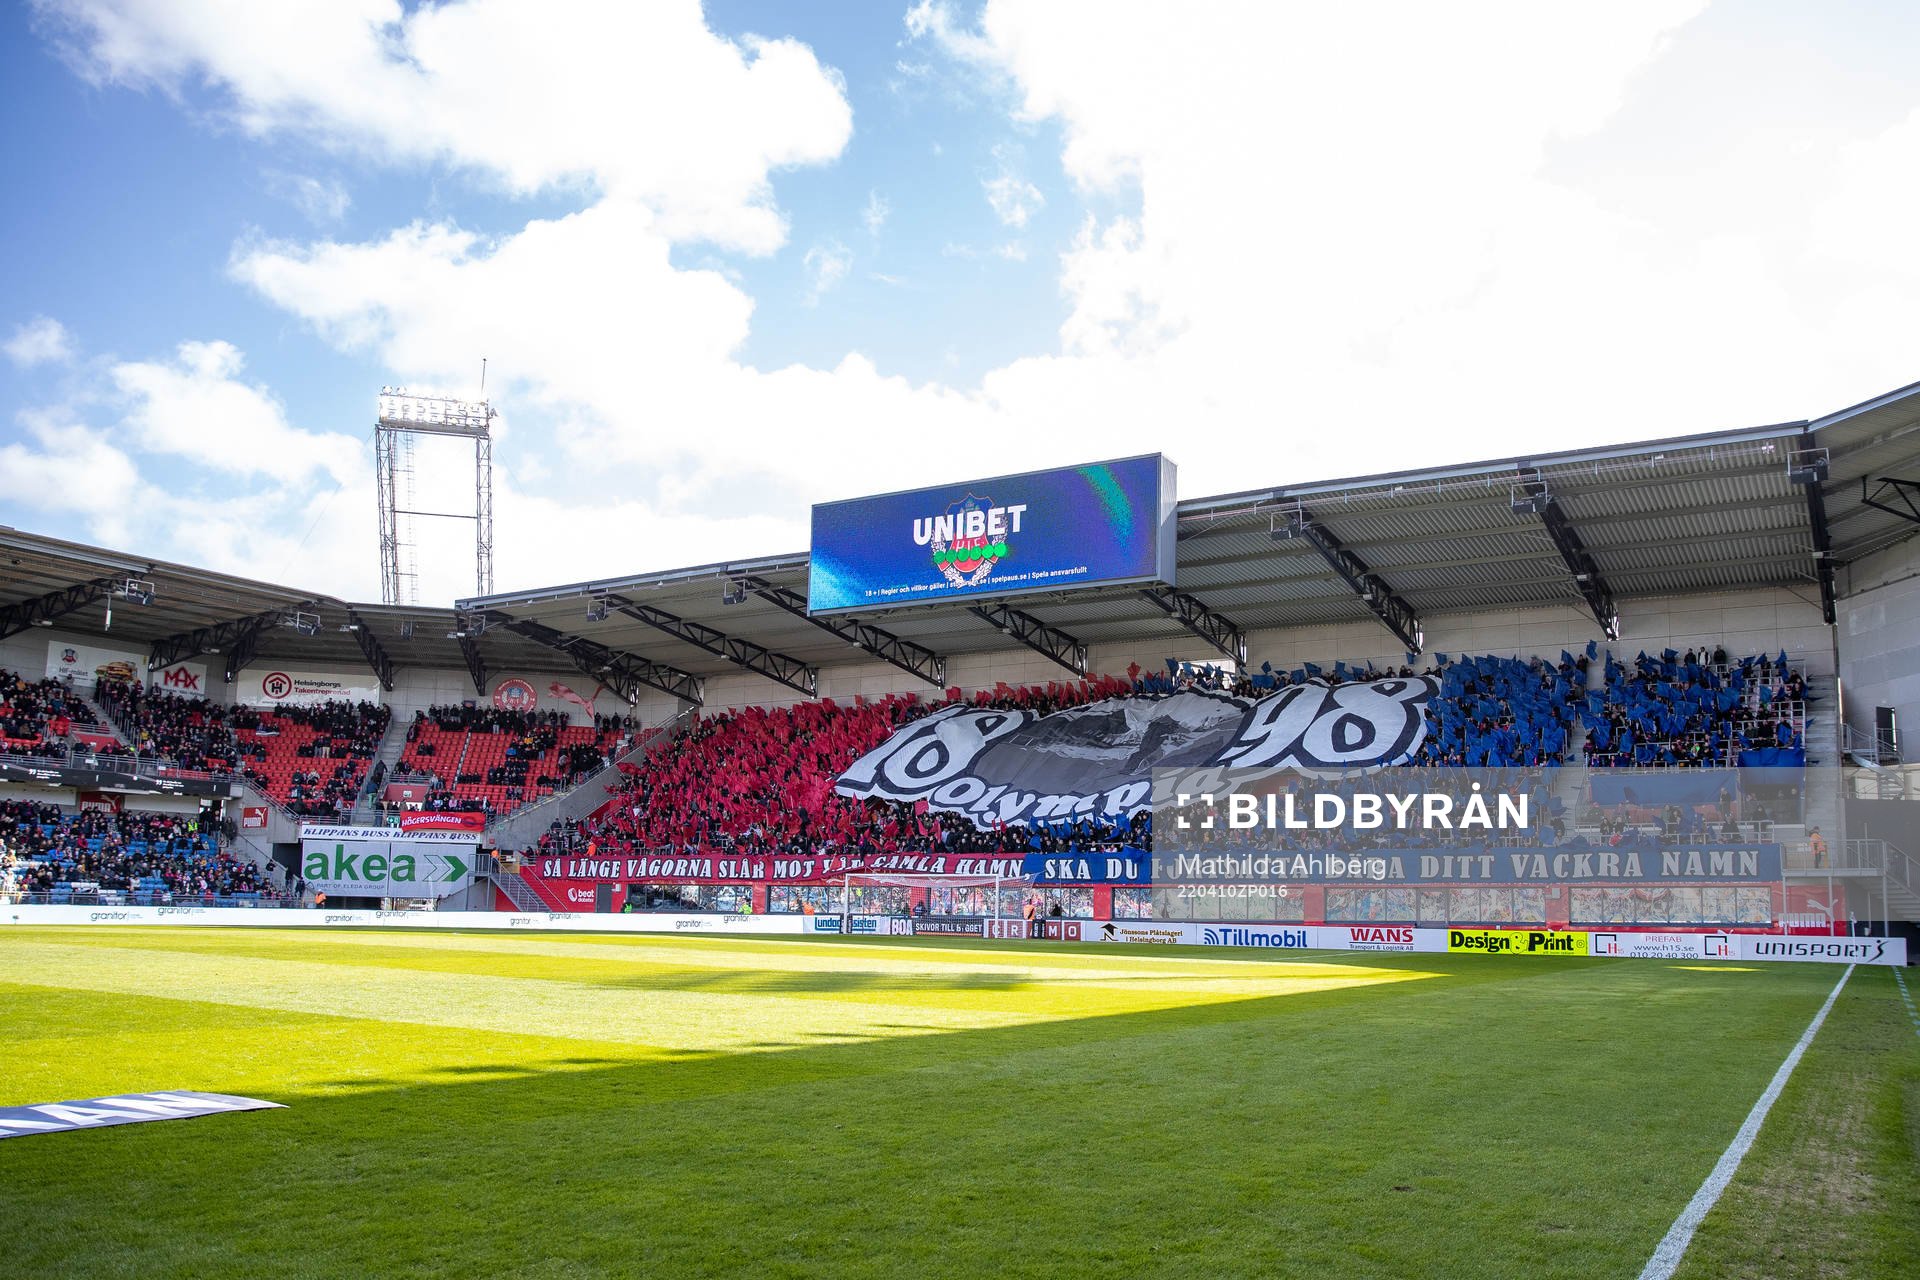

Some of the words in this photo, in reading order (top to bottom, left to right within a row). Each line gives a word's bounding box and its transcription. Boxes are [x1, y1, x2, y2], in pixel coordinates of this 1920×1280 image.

[913, 504, 1027, 546] UNIBET
[992, 574, 1027, 584] spelpaus.se
[1032, 571, 1049, 580] Spela
[1050, 566, 1088, 576] ansvarsfullt
[880, 588, 898, 596] Regler
[911, 584, 928, 592] villkor
[164, 666, 200, 690] MAX
[294, 680, 341, 688] Helsingborgs
[402, 814, 462, 827] HÖGERSVÄNGEN
[304, 828, 358, 837] KLIPPANS
[361, 830, 390, 838] BUSS
[393, 831, 447, 840] KLIPPANS
[450, 833, 478, 841] BUSS
[303, 844, 416, 882] akea
[543, 858, 562, 878] SÅ
[567, 858, 621, 878] LÄNGE
[626, 857, 712, 878] VÅGORNA
[718, 858, 765, 879] SLÅR
[773, 860, 815, 879] MOT
[1045, 858, 1091, 879] SKA
[1106, 858, 1138, 879] DU
[1420, 855, 1495, 879] DITT
[1511, 852, 1643, 879] VACKRA
[1661, 851, 1759, 877] NAMN
[578, 889, 595, 898] beat
[90, 911, 128, 921] granitor
[158, 906, 192, 916] granitor
[325, 914, 352, 924] granitor
[676, 920, 701, 930] granitor
[724, 914, 750, 924] granitor
[1778, 913, 1826, 928] PUMA
[892, 918, 913, 936] BOA
[915, 923, 940, 932] SKIVOR
[940, 923, 954, 932] TILL
[956, 924, 982, 933] BGGET
[1120, 928, 1148, 936] Jönssons
[1150, 929, 1183, 938] Plåtslageri
[1130, 936, 1166, 944] Helsingborg
[1219, 928, 1308, 948] Tillmobil
[1350, 928, 1414, 942] WANS
[1634, 944, 1695, 952] www.h15.se
